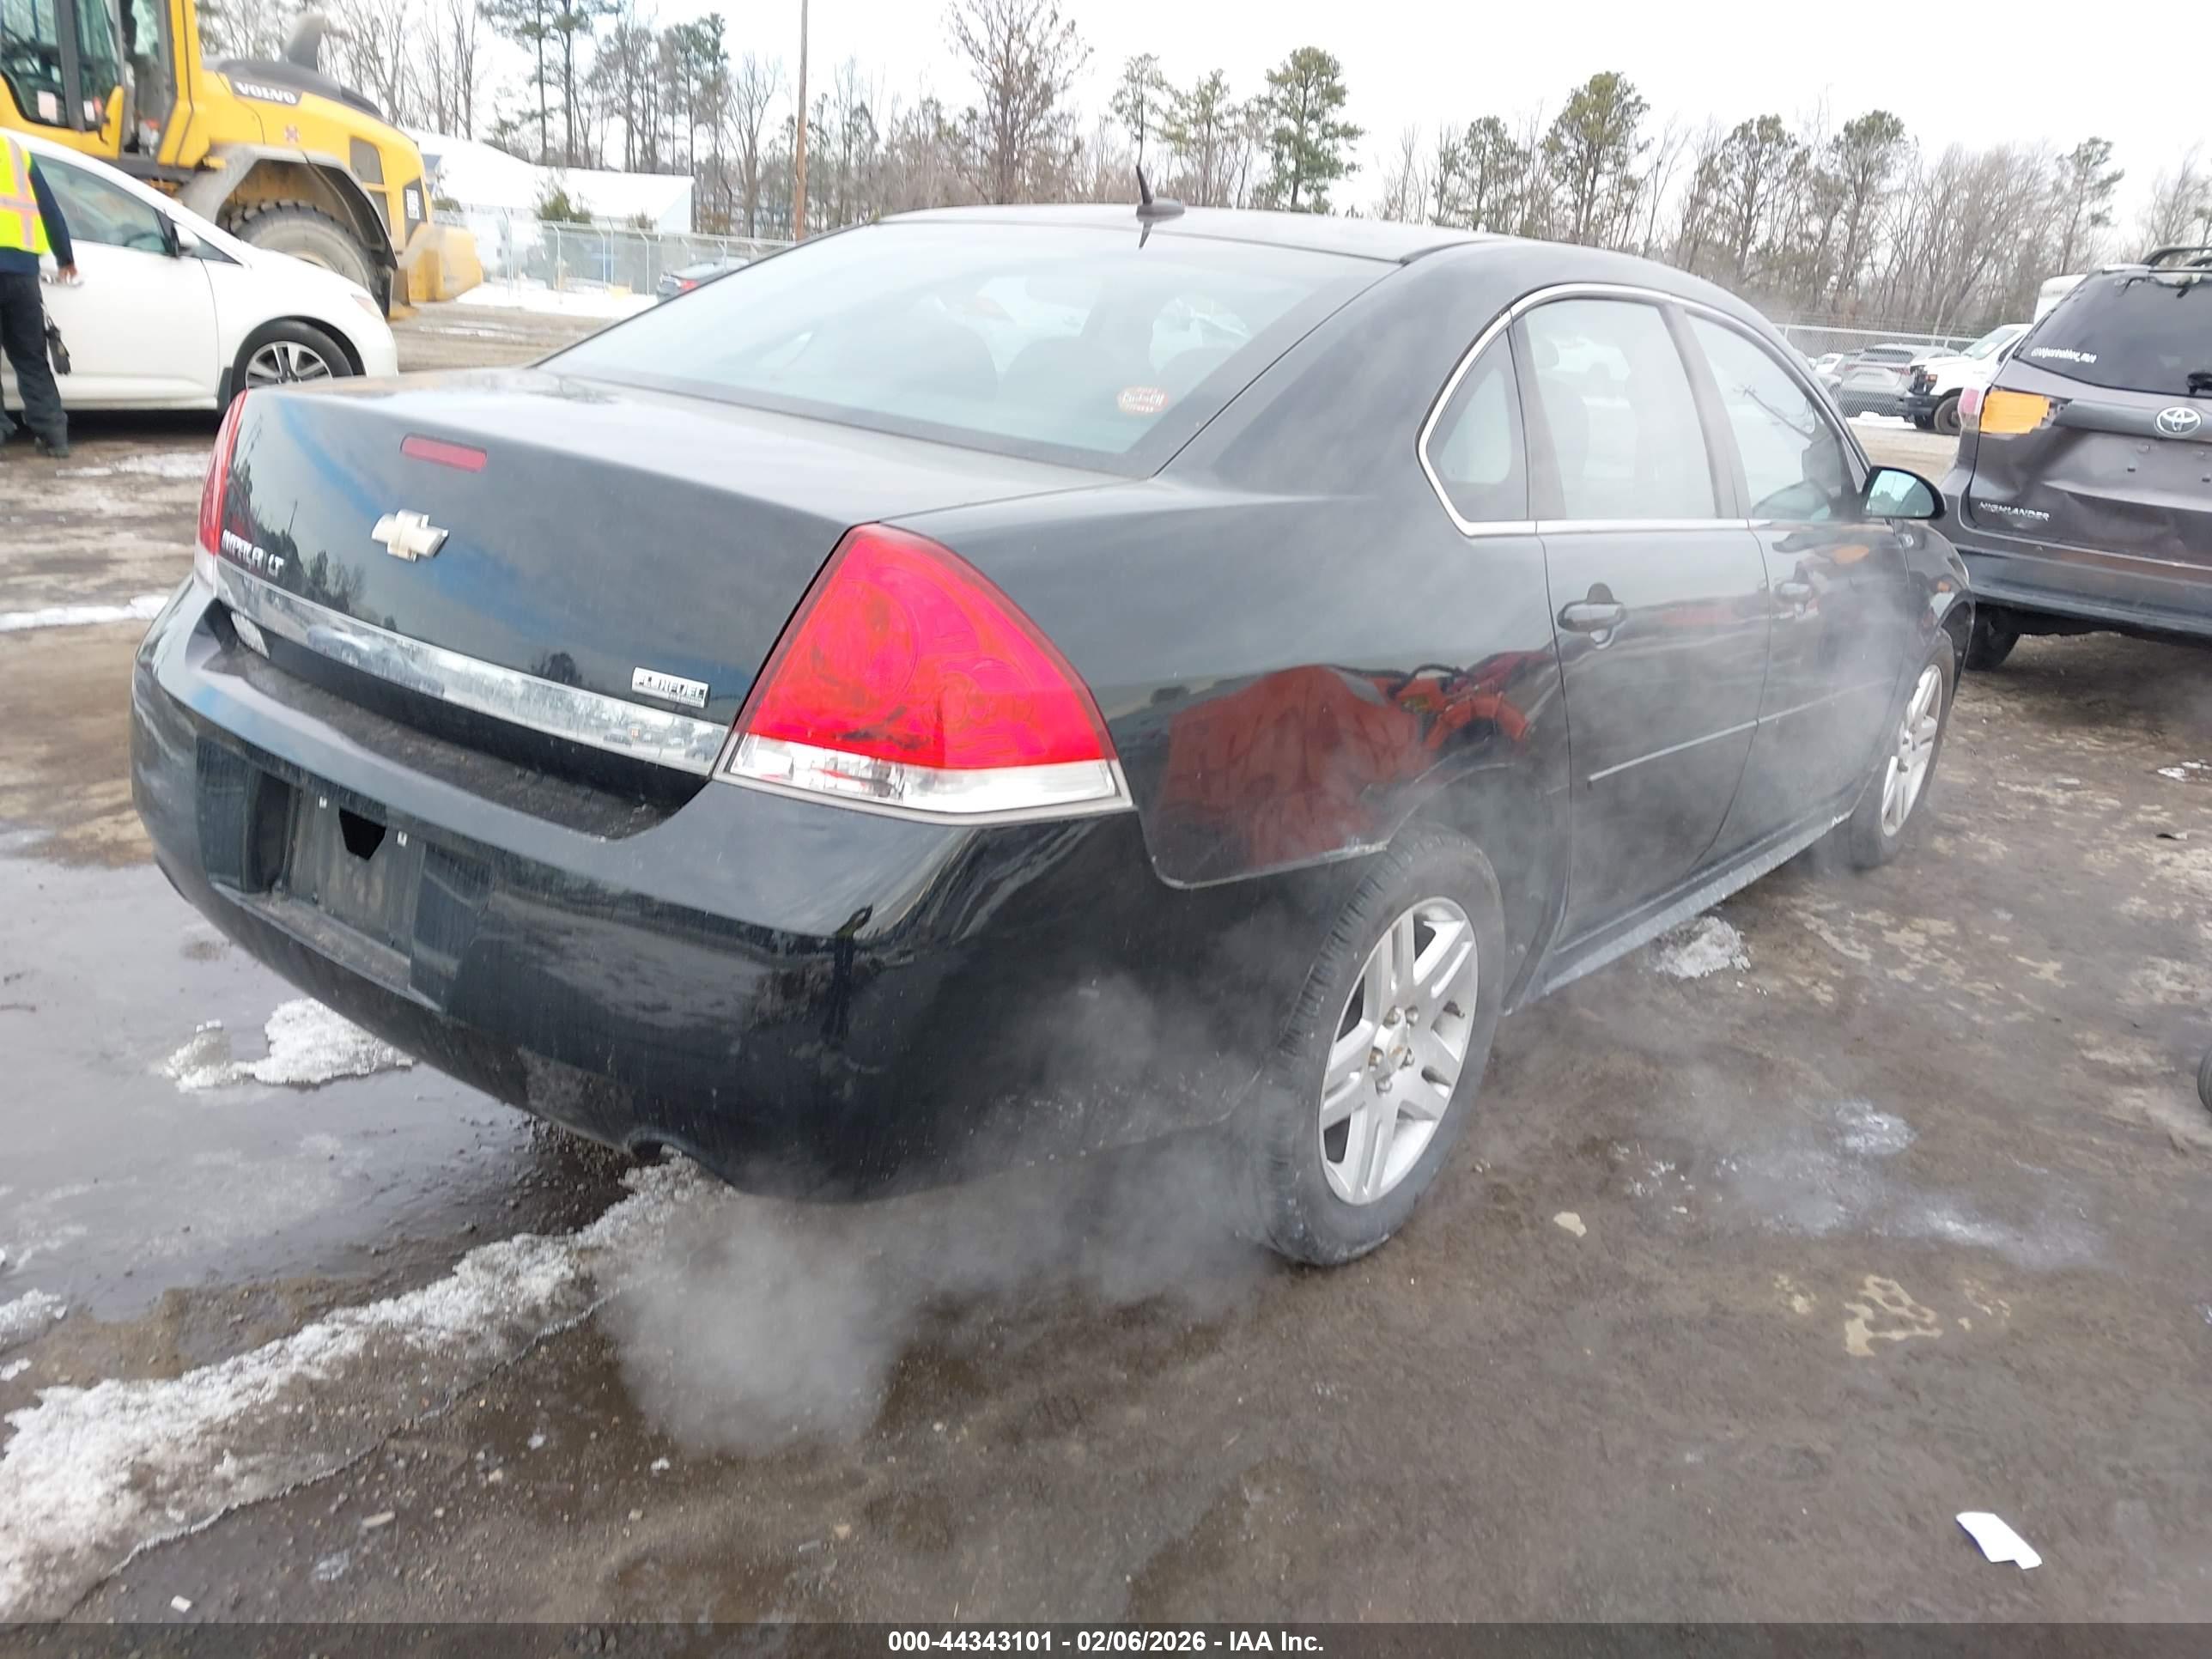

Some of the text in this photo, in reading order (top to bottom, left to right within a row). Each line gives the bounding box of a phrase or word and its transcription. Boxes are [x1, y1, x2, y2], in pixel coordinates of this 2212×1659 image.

[234, 81, 296, 104] VOLVO
[1978, 501, 2051, 522] HIGHLANDER
[267, 553, 285, 578] LT
